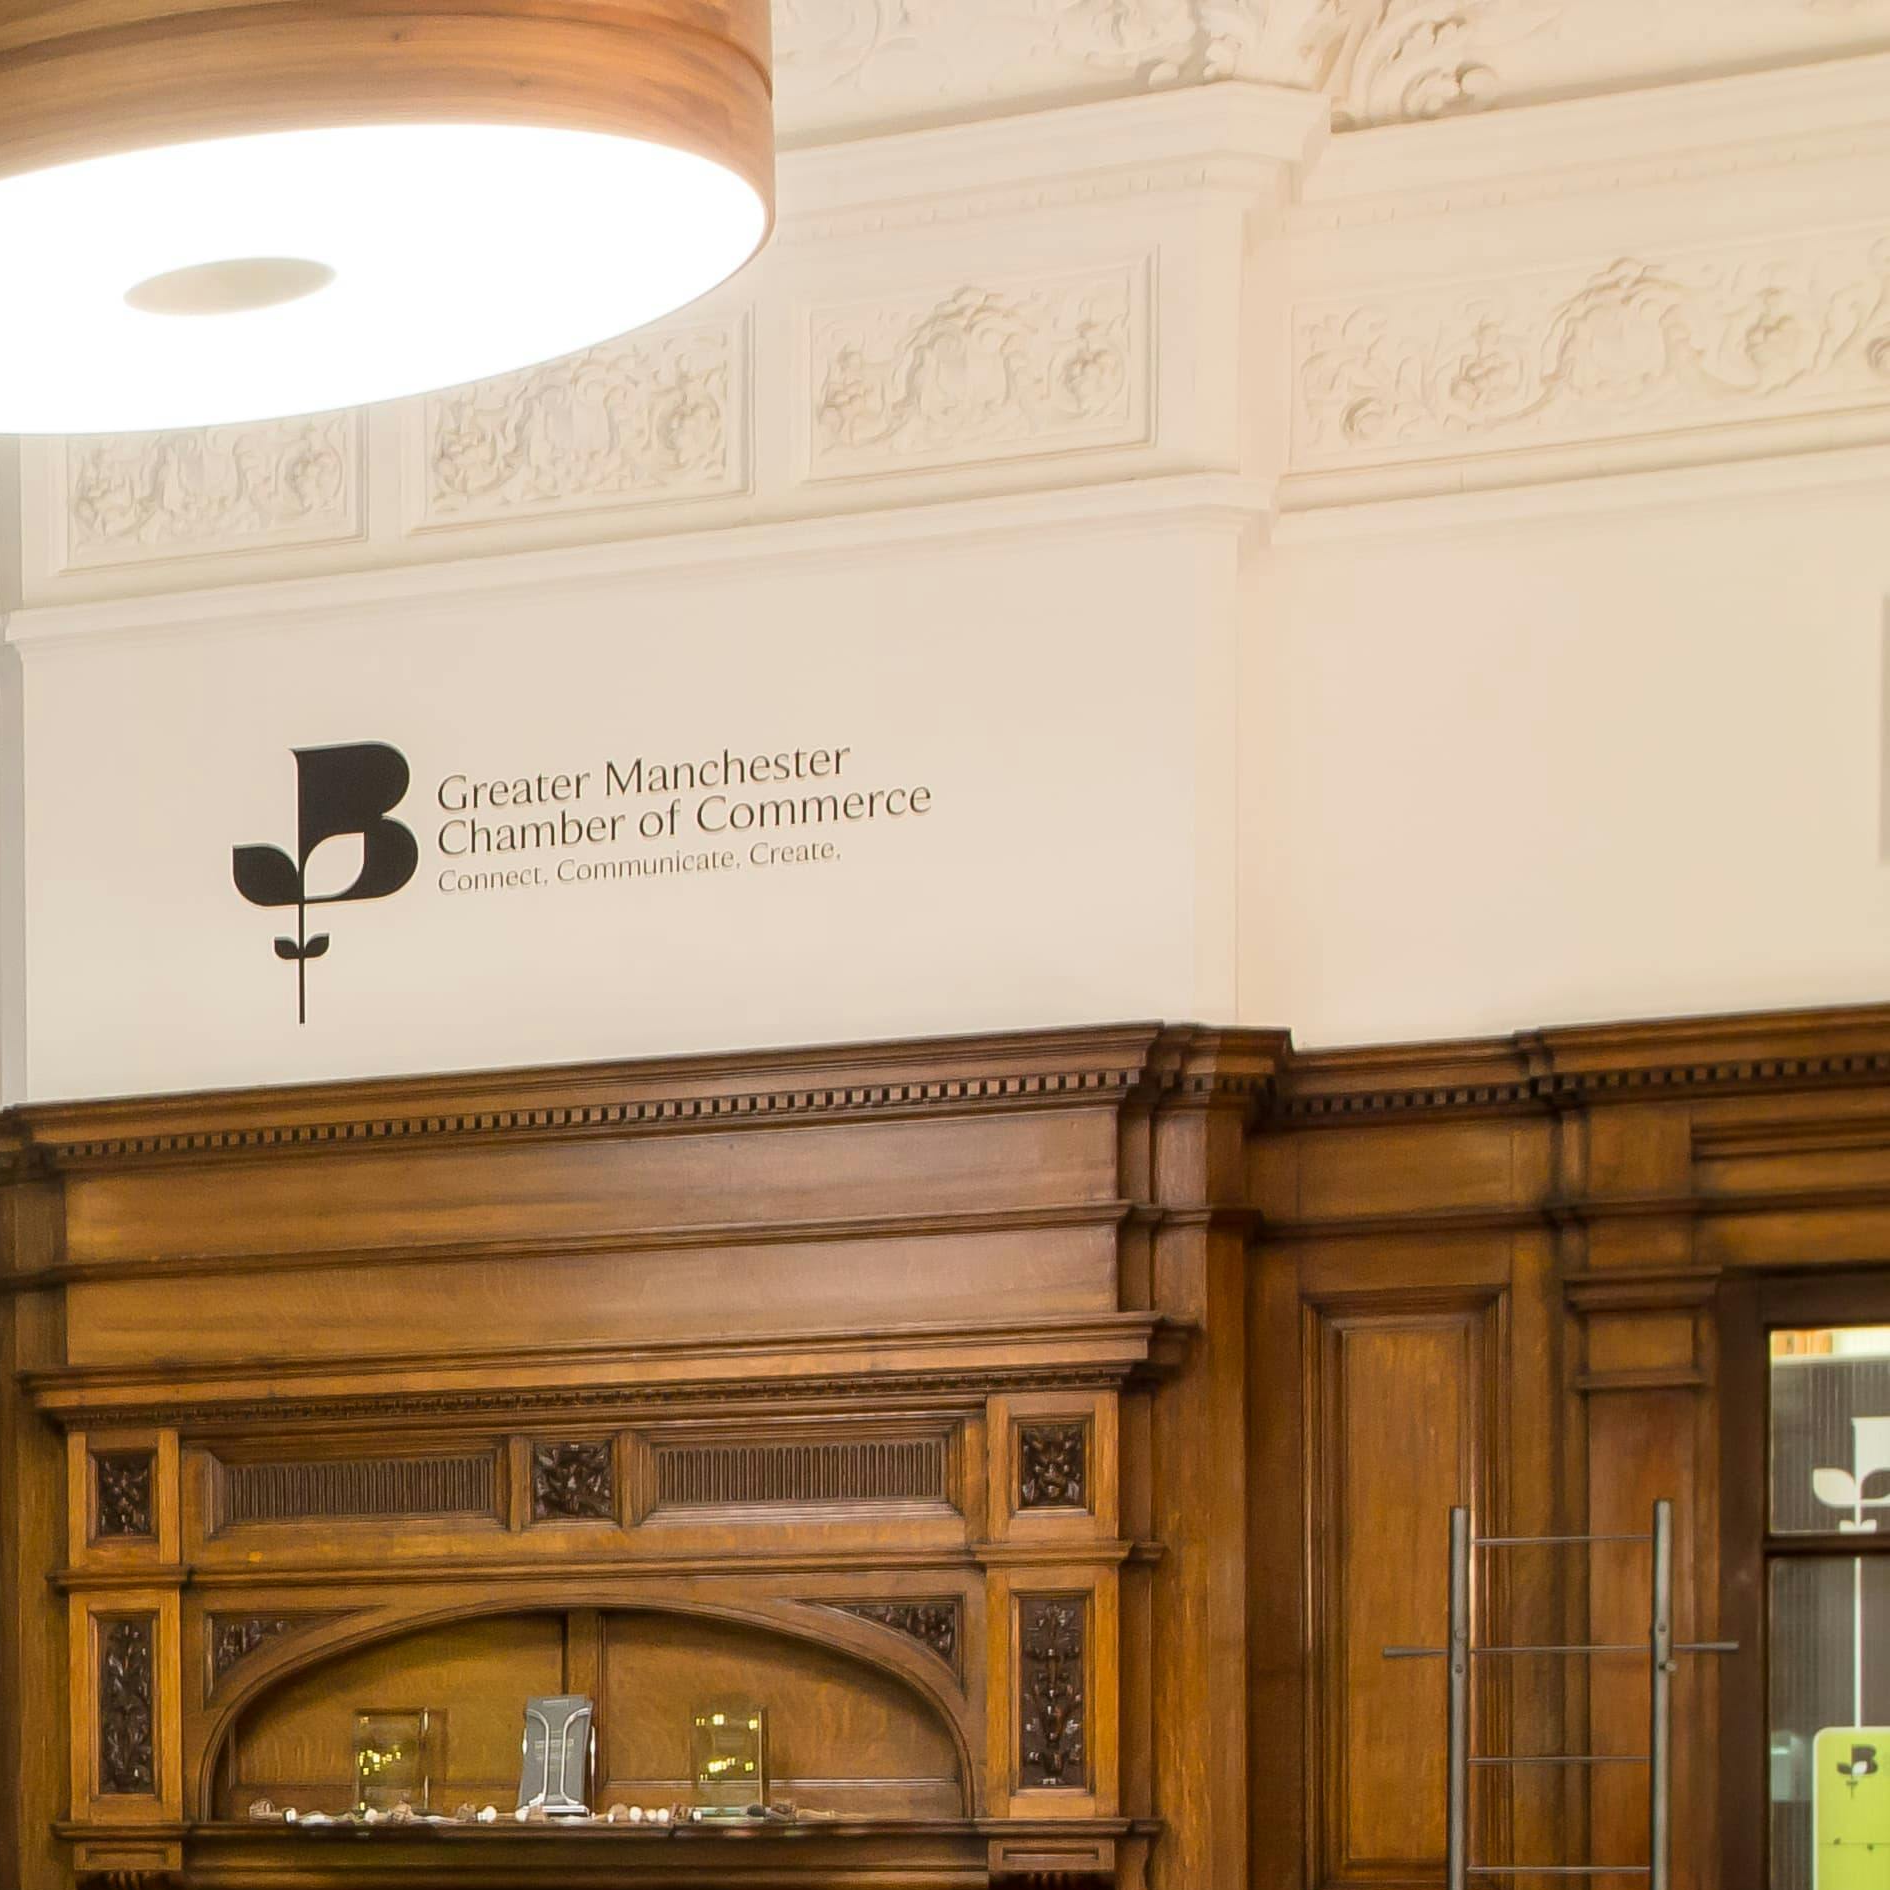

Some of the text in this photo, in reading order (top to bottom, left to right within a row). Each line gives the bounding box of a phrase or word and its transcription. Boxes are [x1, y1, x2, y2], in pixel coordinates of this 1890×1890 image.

[437, 746, 851, 812] Greater Manchester
[437, 784, 932, 856] Chamber of Commerce
